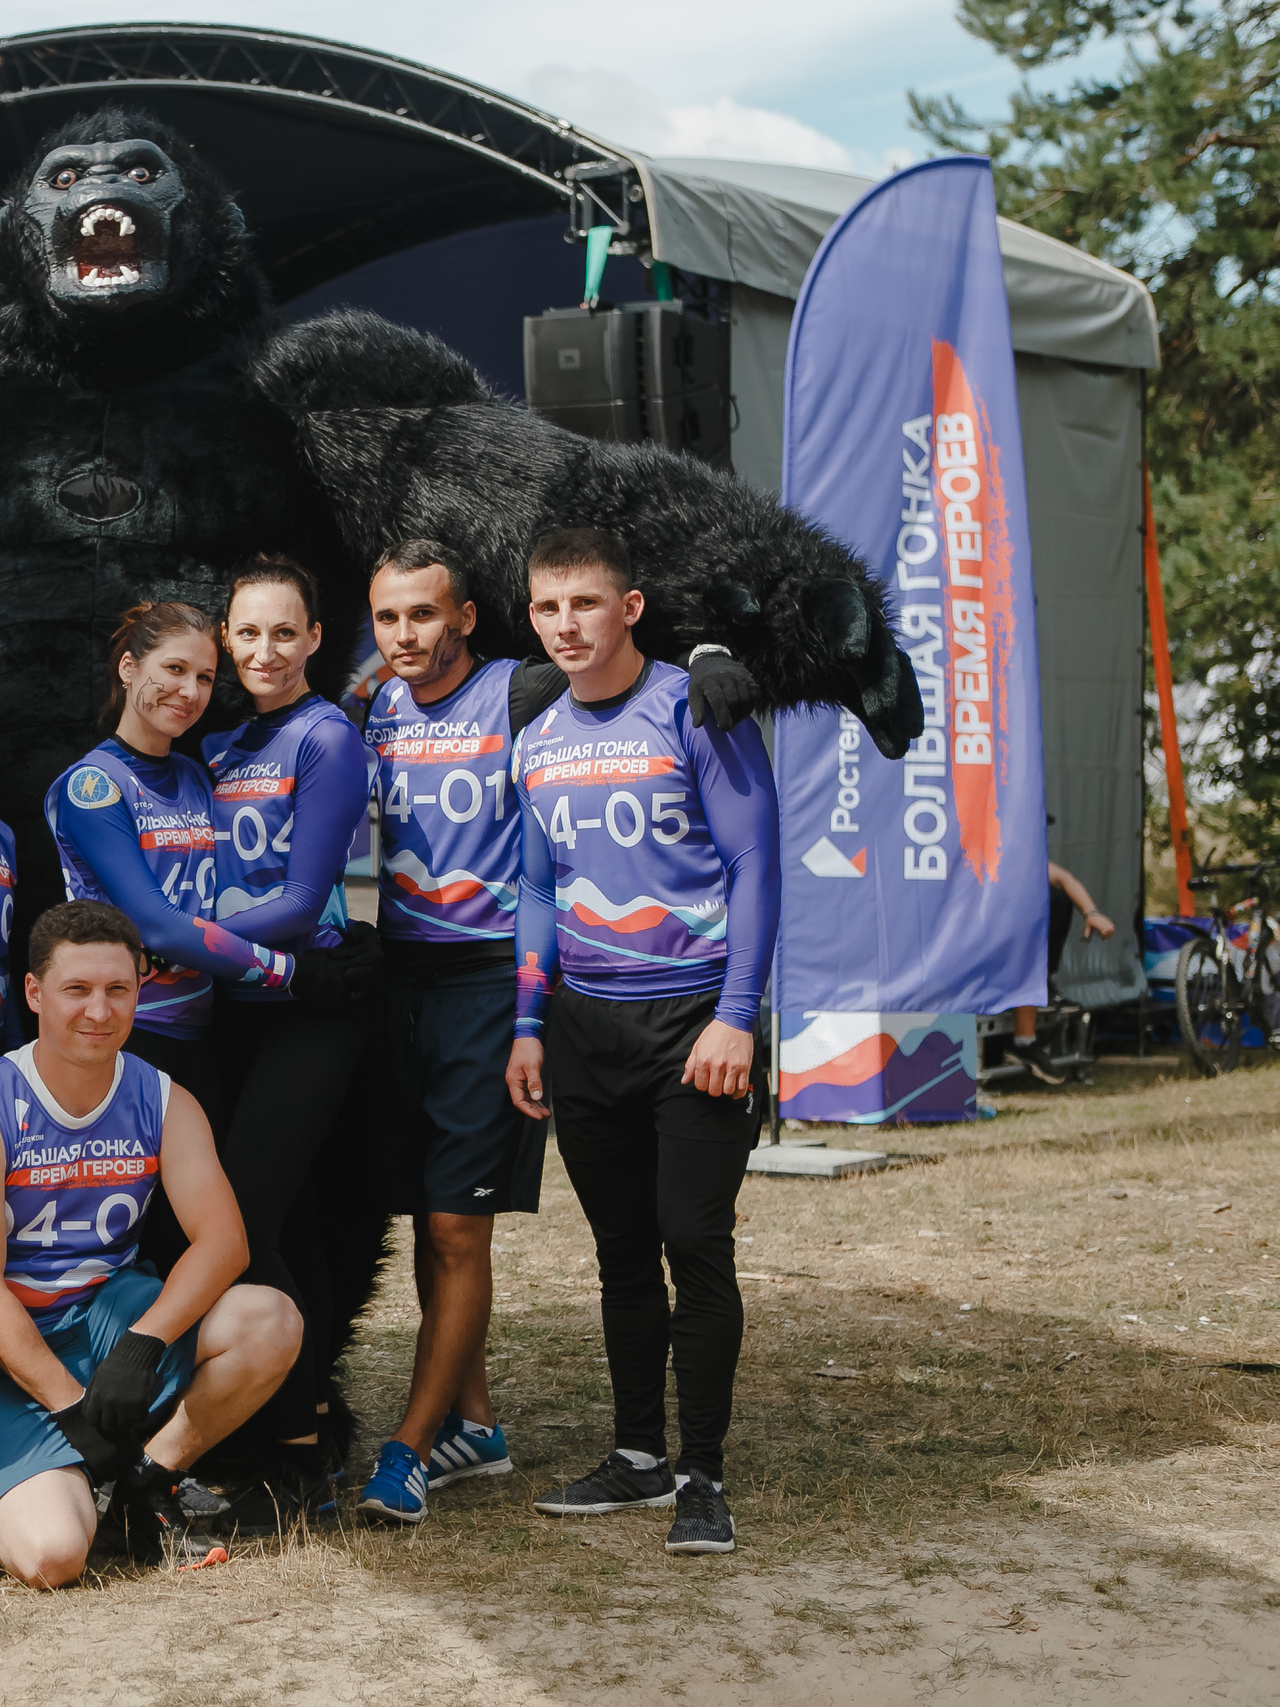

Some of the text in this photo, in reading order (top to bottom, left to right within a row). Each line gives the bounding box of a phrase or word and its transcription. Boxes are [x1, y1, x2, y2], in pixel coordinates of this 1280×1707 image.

[935, 411, 993, 765] ВРЕМЯ ГЕРОЕВ
[896, 413, 948, 881] БОЛЬШАЯ ГОНКА
[365, 721, 481, 745] БОЛЬШАЯ ГОНКА
[382, 739, 480, 756] ВРЕМЯ ГЕРОЕВ
[595, 740, 650, 759] ГОНКА
[244, 762, 282, 778] ГОНКА
[543, 758, 650, 783] ВРЕМЯ ГЕРОЕВ
[830, 711, 861, 833] Ростел
[238, 778, 280, 793] ГЕРОЕВ
[377, 768, 507, 824] 4-01
[154, 830, 192, 847] ВРЕМЯ
[82, 1139, 145, 1158] ГОНКА
[29, 1159, 146, 1186] ВРЕМЯ ГЕРОЕВ
[6, 1190, 150, 1248] 4-0
